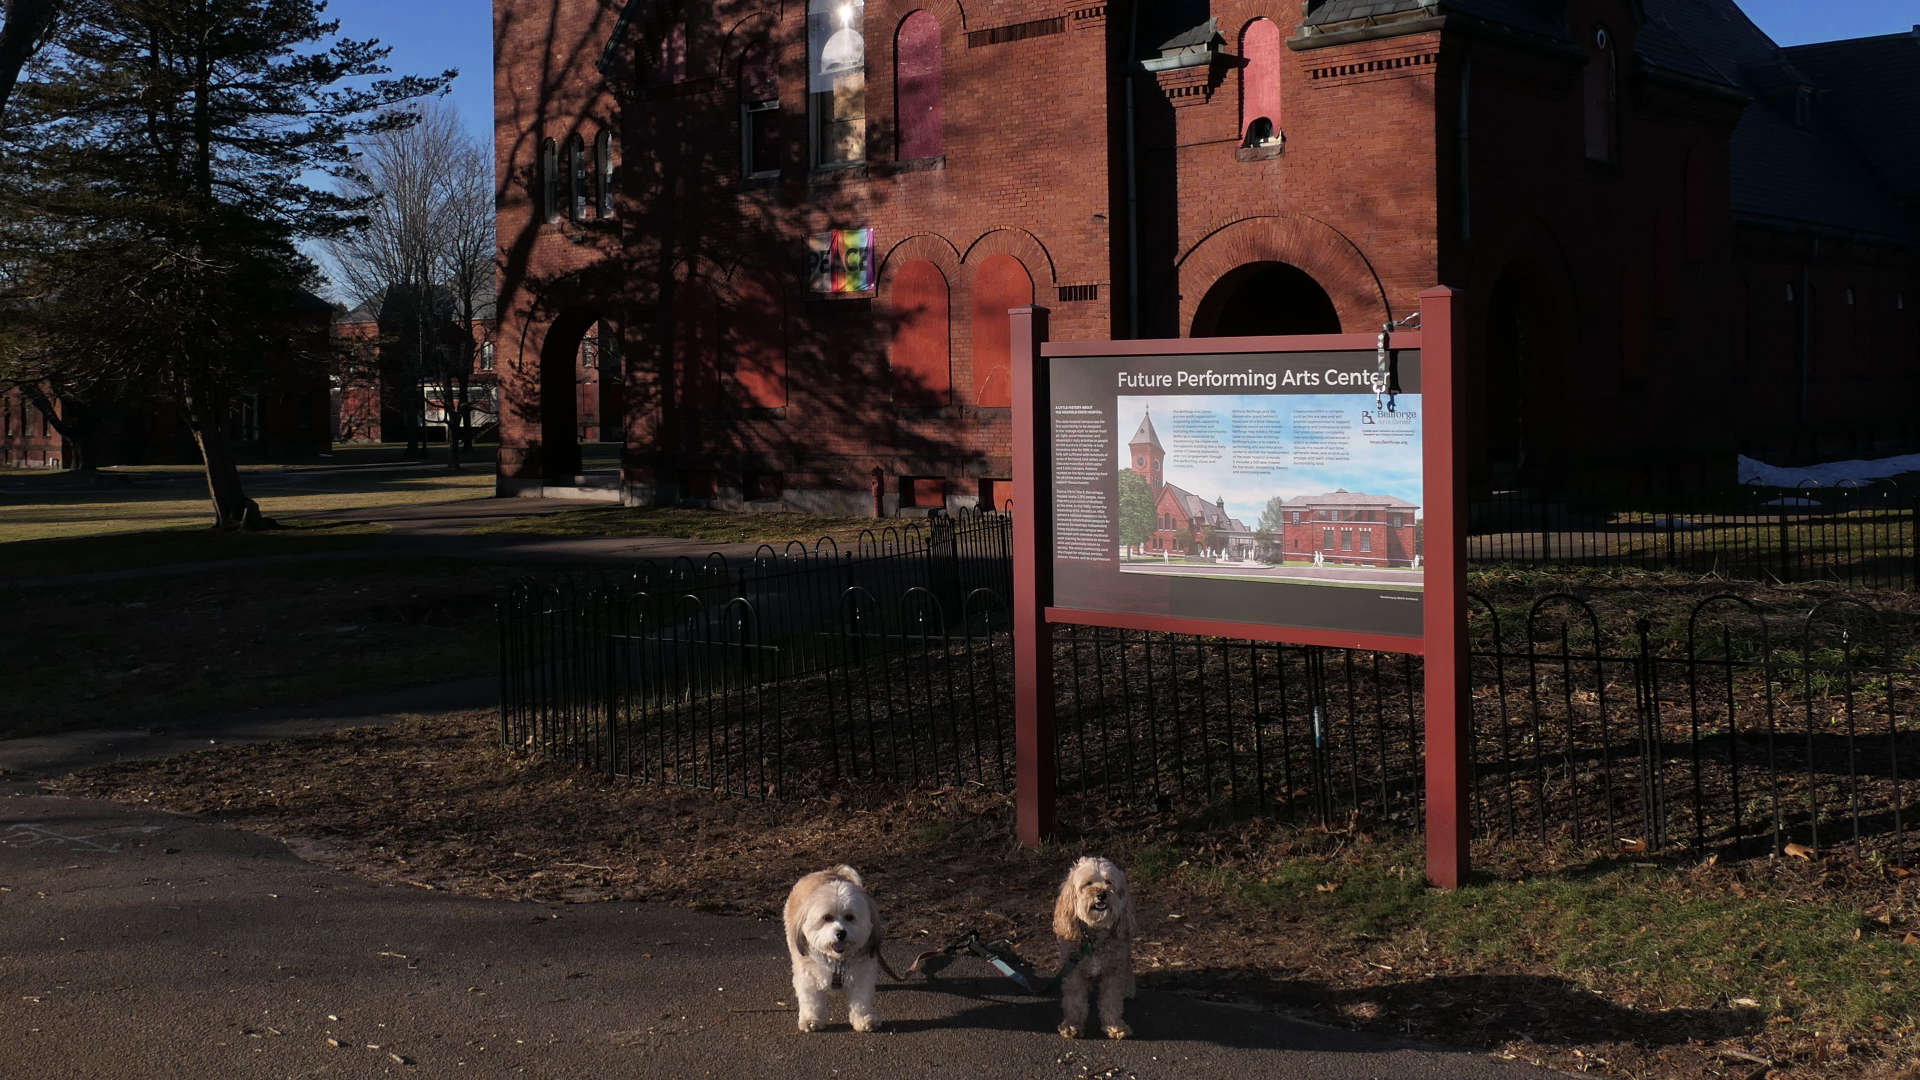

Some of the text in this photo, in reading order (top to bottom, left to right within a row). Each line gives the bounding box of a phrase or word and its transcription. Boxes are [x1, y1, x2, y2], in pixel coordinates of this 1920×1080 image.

[807, 247, 868, 273] PEACE
[1118, 371, 1172, 388] Future
[1177, 369, 1276, 390] Performing
[1281, 369, 1320, 386] Arts
